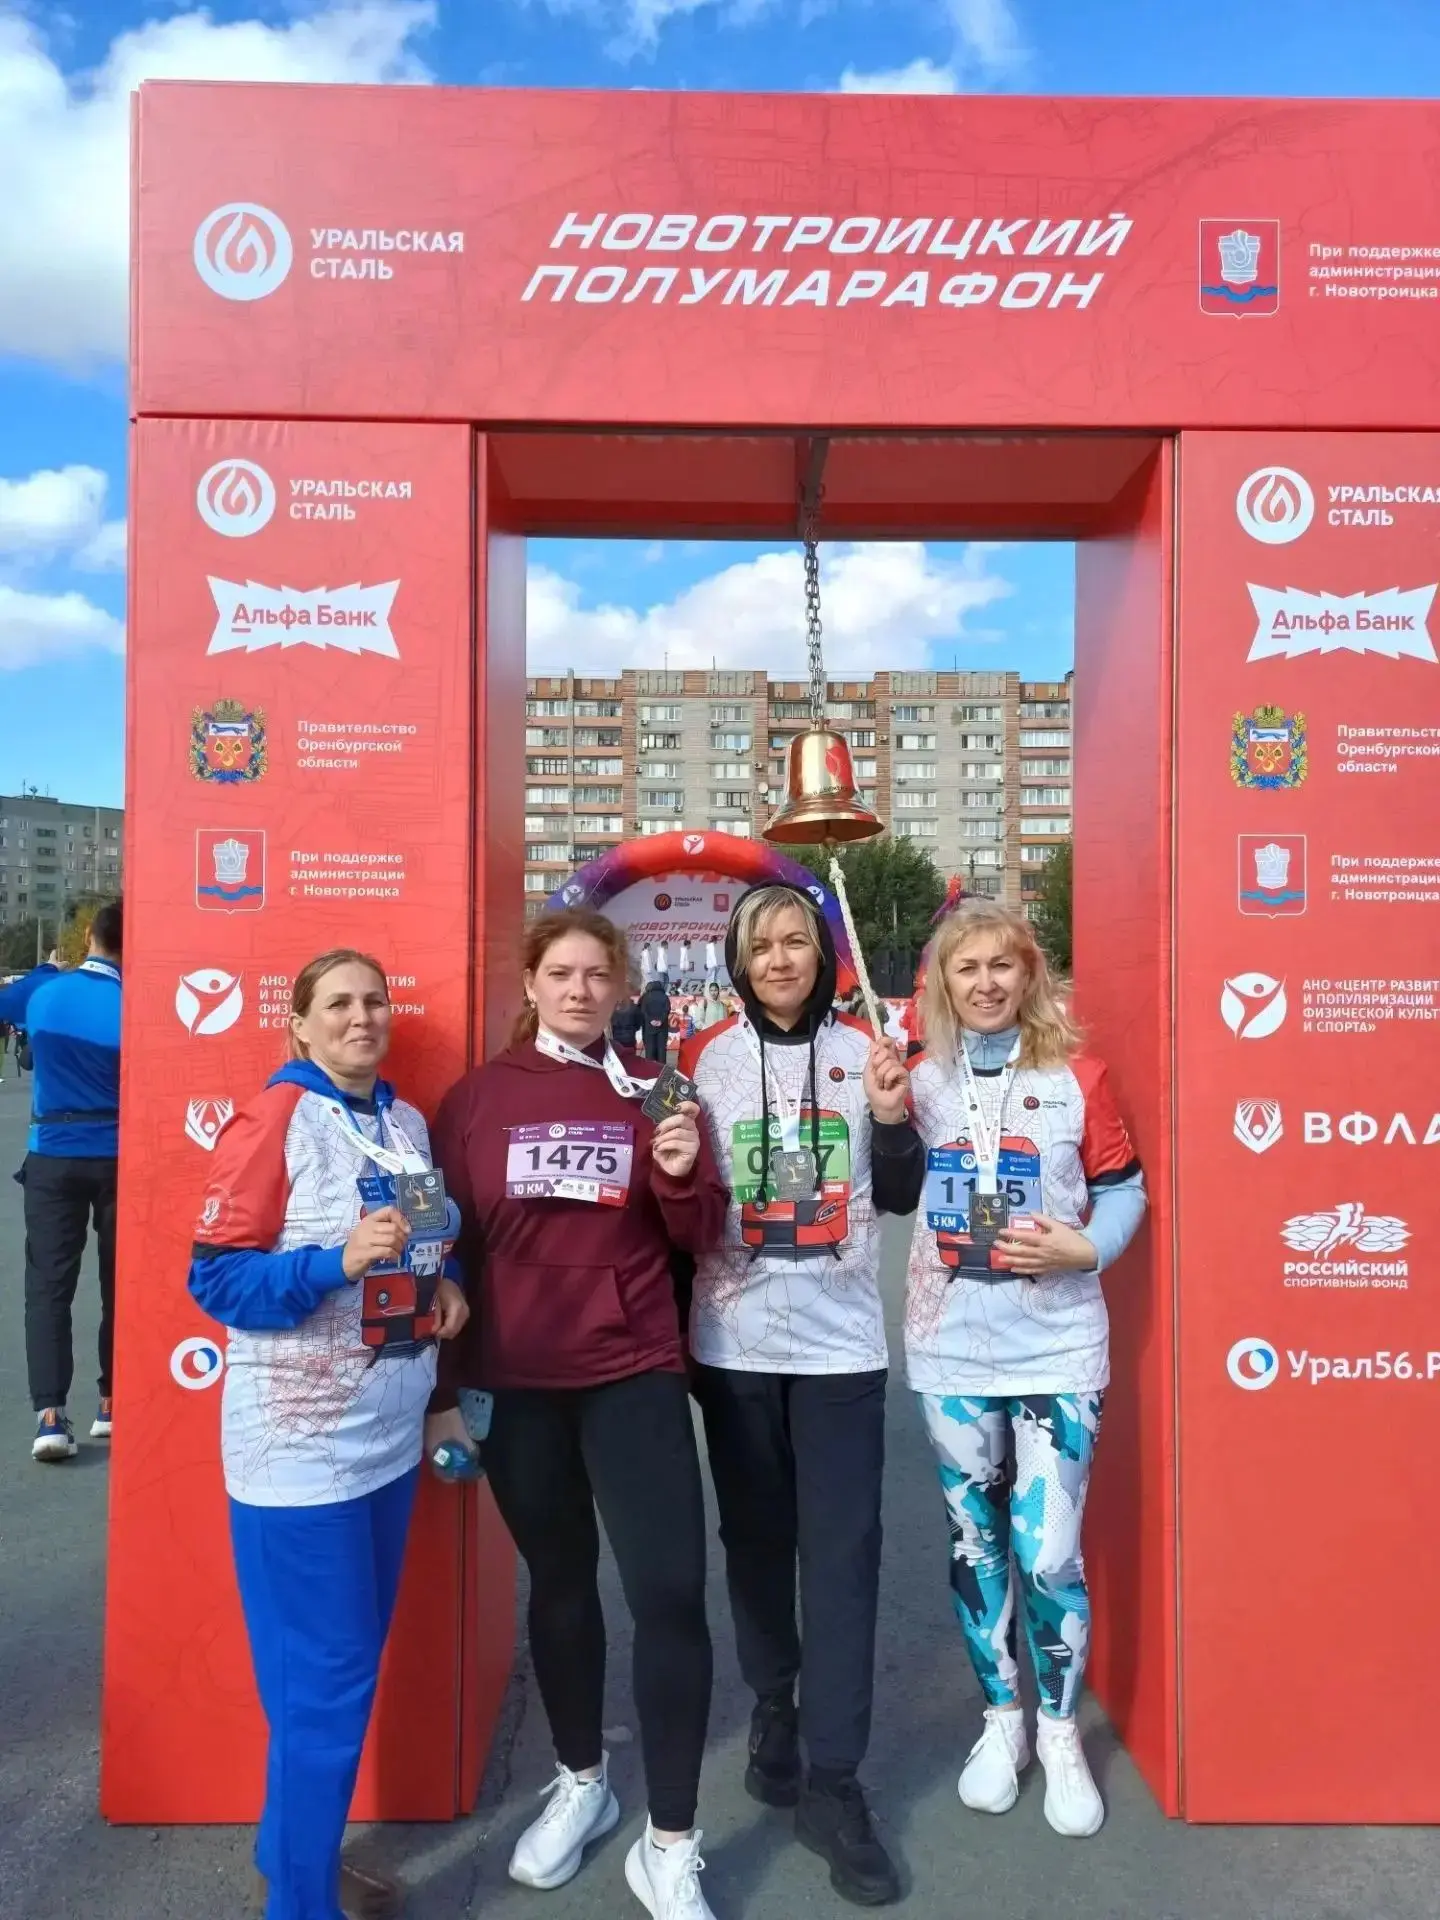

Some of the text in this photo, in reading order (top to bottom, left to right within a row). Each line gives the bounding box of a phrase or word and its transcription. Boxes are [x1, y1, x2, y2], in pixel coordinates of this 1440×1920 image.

[310, 228, 464, 253] УРАЛЬСКАЯ
[550, 212, 1134, 260] НОВОТРОИЦКИЙ
[1309, 243, 1440, 262] При поддержке
[310, 257, 394, 280] СТАЛЬ
[521, 264, 1105, 309] ПОЛУМАРАФОН
[1309, 284, 1438, 300] г. Новотроицка
[289, 479, 412, 499] УРАЛЬСКАЯ
[289, 502, 356, 521] СТАЛЬ
[1327, 508, 1394, 526] СТАЛЬ
[231, 602, 377, 631] Альфа Банк
[1271, 609, 1415, 636] Альфа Банк
[297, 721, 417, 736] Правительство
[297, 738, 402, 754] Оренбургской
[1337, 742, 1440, 758] Оренбургской
[297, 756, 358, 769] области
[1337, 759, 1397, 773] области
[290, 851, 403, 867] При поддержке
[1331, 854, 1440, 870] При поддержке
[290, 870, 405, 883] администрации
[290, 884, 400, 899] г. Новотроицка
[1331, 889, 1440, 903] г. Новотроицка
[259, 975, 288, 987] АНО
[1303, 979, 1440, 993] АНО «ЦЕНТР РАЗВИТ
[259, 989, 269, 1001] И
[1303, 993, 1434, 1007] И ПОПУЛЯРИЗАЦИИ
[1302, 1005, 1394, 1020] ФИЗИЧЕСКОЙ
[259, 1018, 268, 1029] И
[1303, 1020, 1377, 1033] И СПОРТА»
[526, 1144, 618, 1175] 1475
[512, 1184, 525, 1195] 10
[940, 1176, 1026, 1207] 115
[933, 1215, 940, 1226] 5
[1283, 1258, 1409, 1276] РОССИЙСКИЙ
[1283, 1276, 1409, 1290] СПОРТИВНЫЙ ФОНД
[1287, 1350, 1440, 1385] Урал56.Р
